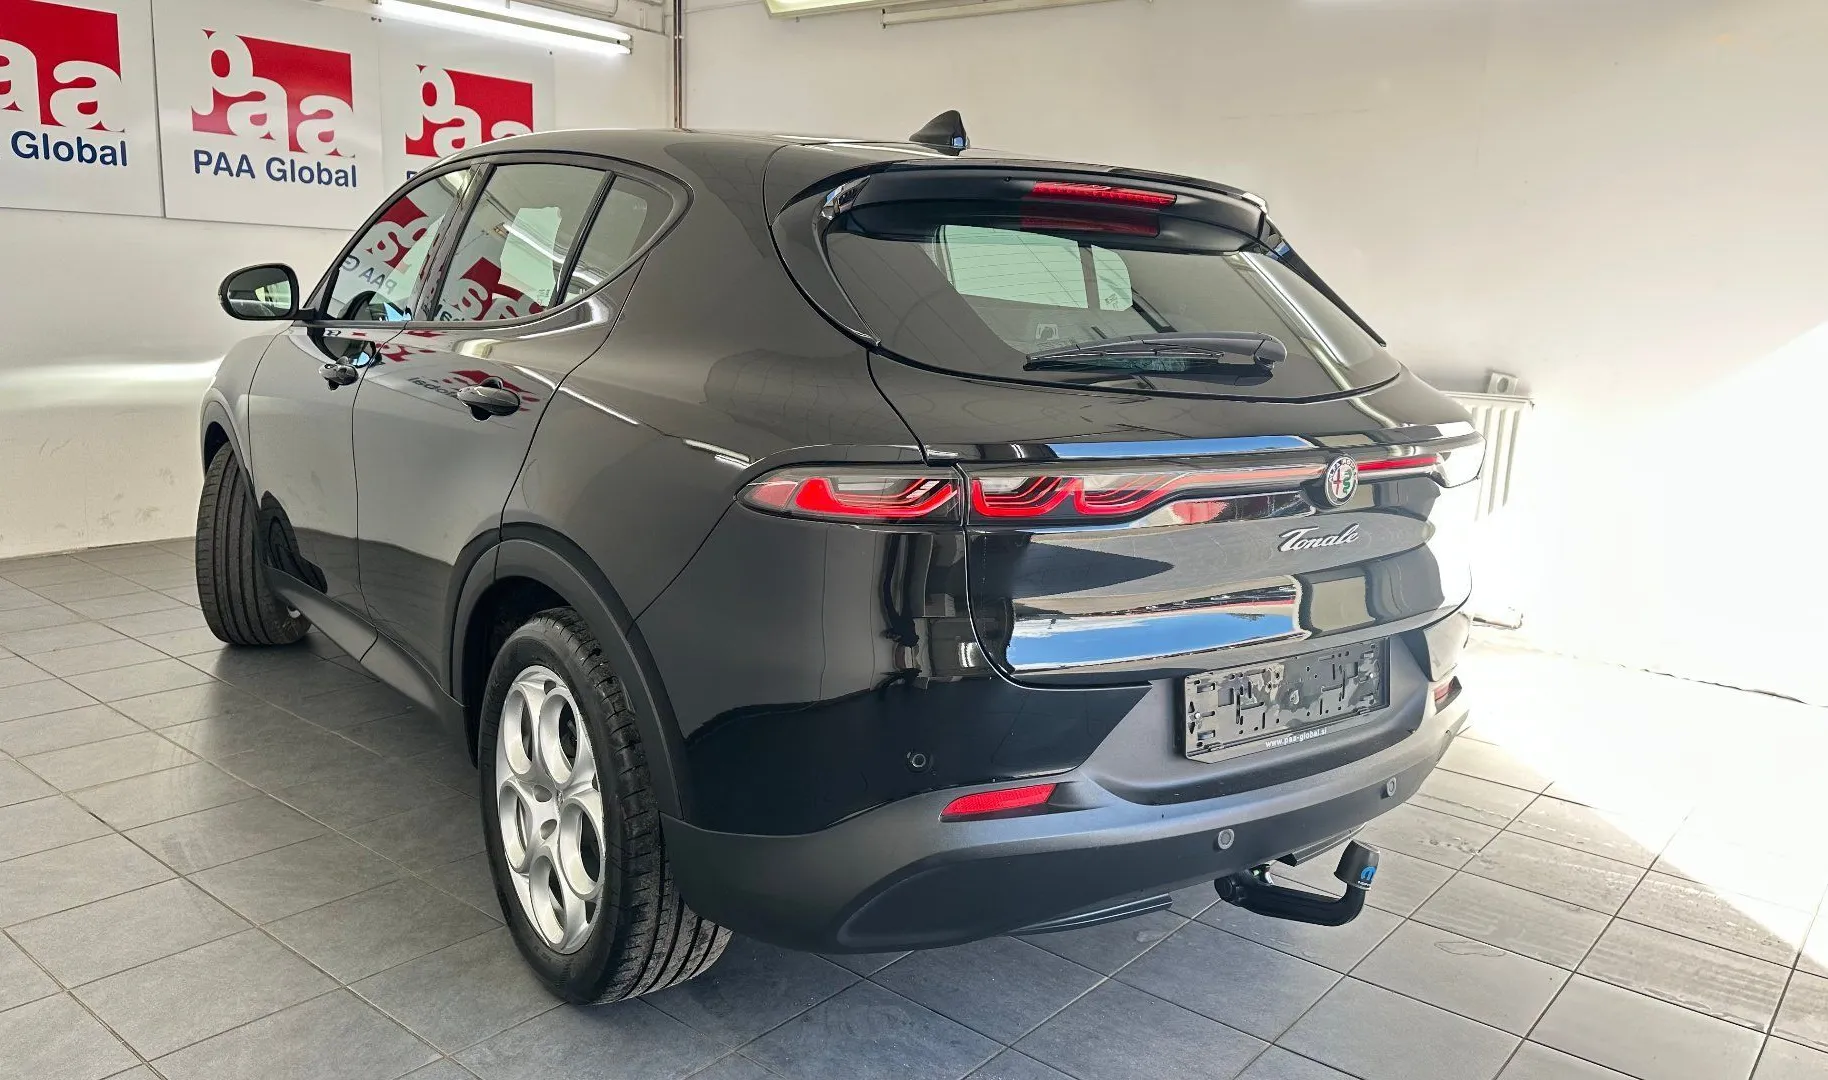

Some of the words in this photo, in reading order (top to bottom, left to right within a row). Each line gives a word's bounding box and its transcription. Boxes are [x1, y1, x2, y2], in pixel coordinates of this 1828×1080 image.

[191, 27, 355, 158] paa
[11, 130, 128, 167] Global
[193, 149, 256, 179] PAA
[265, 156, 357, 188] Global
[1278, 522, 1360, 552] Tonale
[1265, 727, 1328, 748] www.paa-global.si
